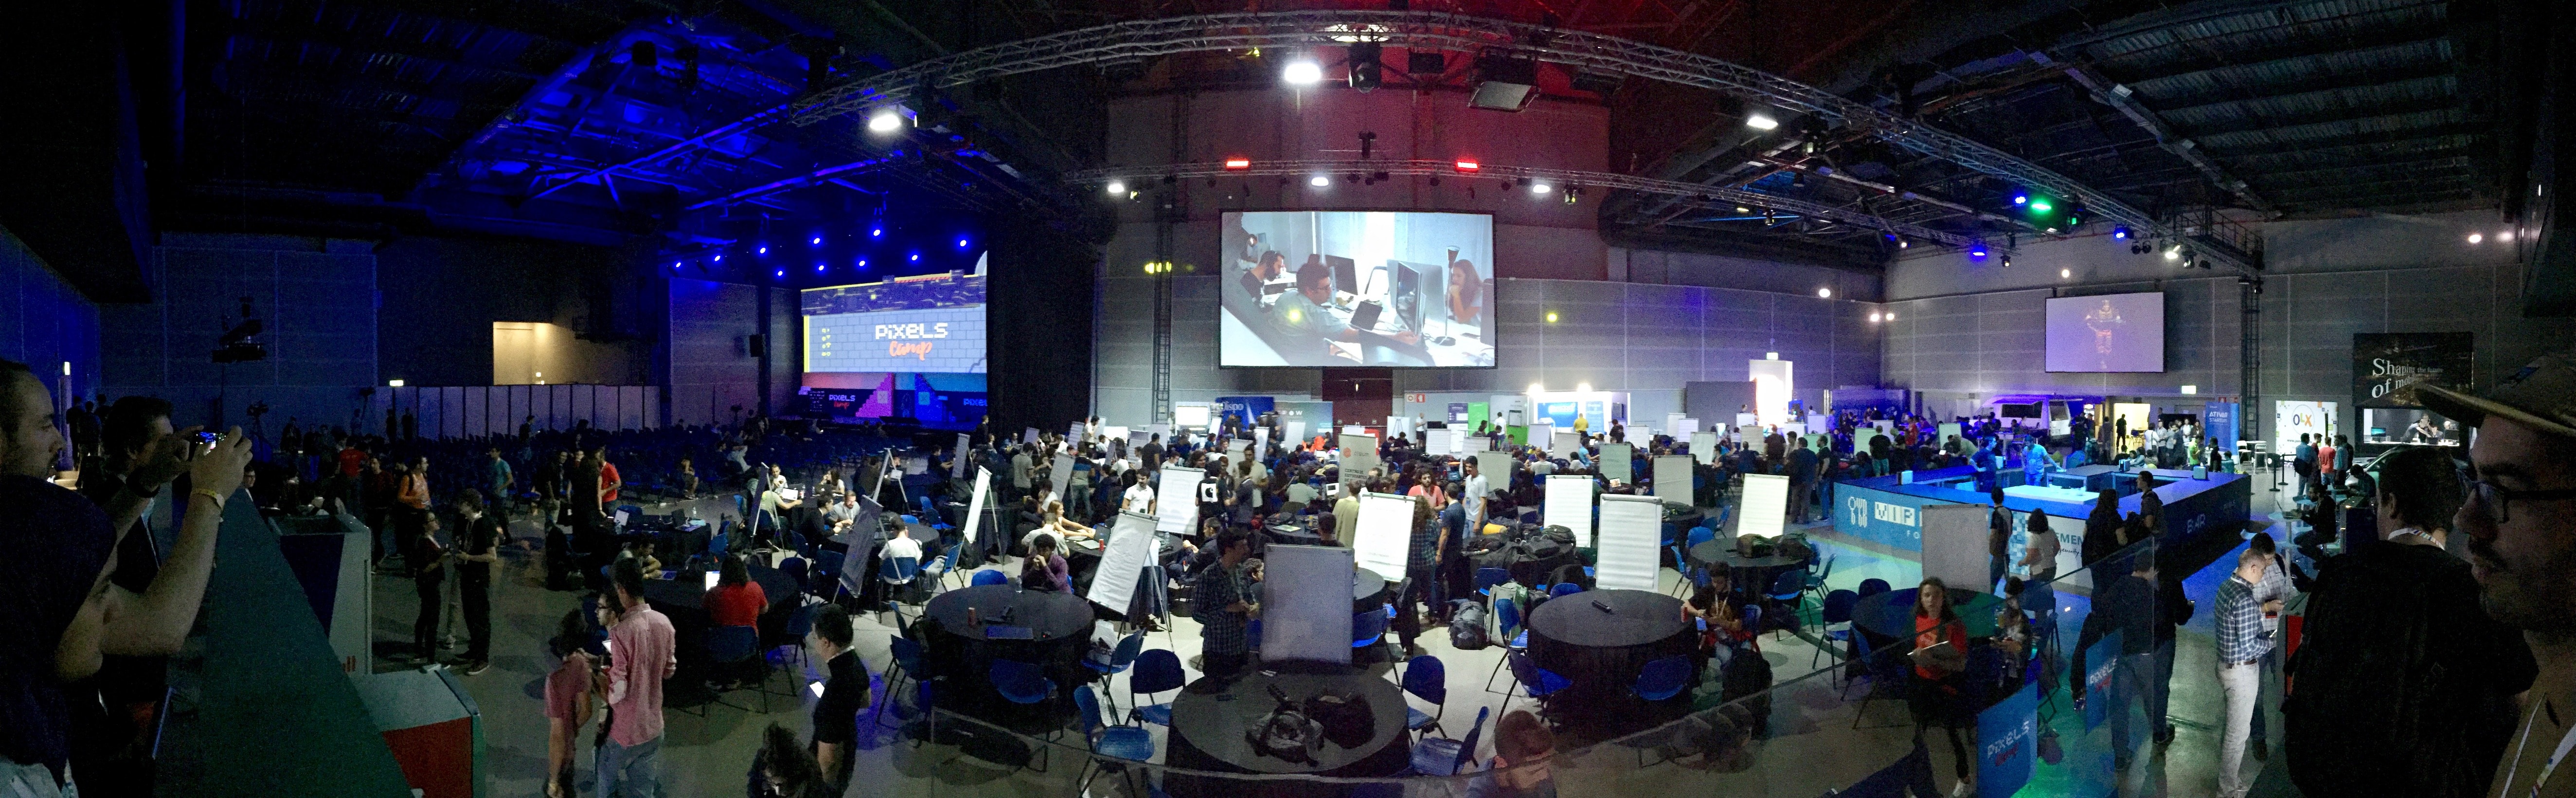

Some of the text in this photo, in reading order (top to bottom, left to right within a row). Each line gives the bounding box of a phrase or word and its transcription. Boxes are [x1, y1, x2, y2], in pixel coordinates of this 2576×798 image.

[2373, 358, 2415, 376] Shaping
[2372, 378, 2391, 398] of
[2293, 413, 2312, 427] OLX
[1876, 503, 1913, 525] VIP
